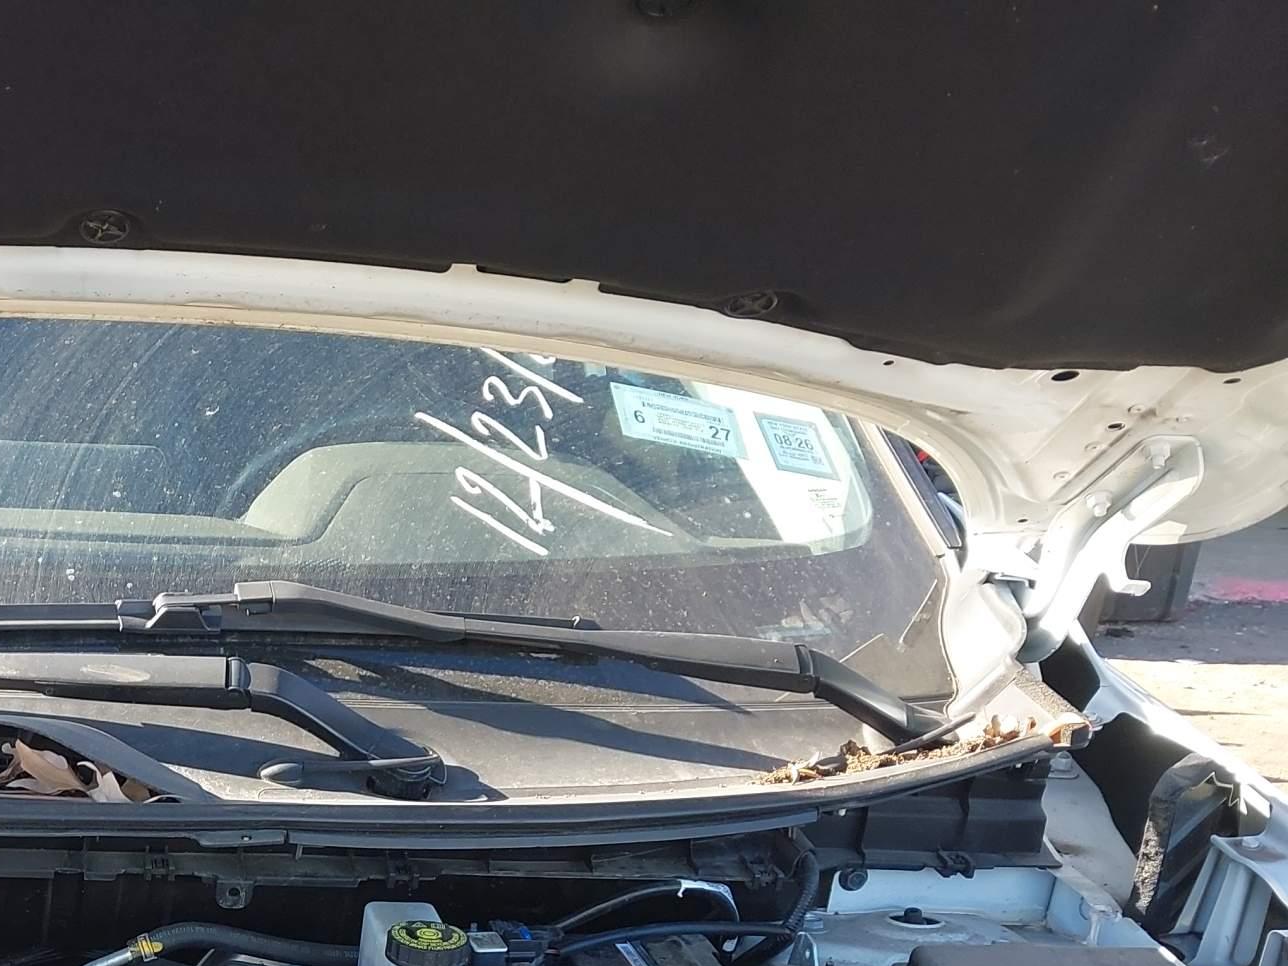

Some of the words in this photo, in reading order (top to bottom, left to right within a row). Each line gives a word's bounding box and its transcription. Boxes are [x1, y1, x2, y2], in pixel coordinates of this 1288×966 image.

[633, 409, 646, 424] 6
[708, 424, 732, 441] 27
[773, 433, 793, 447] 08
[796, 438, 815, 450] 26
